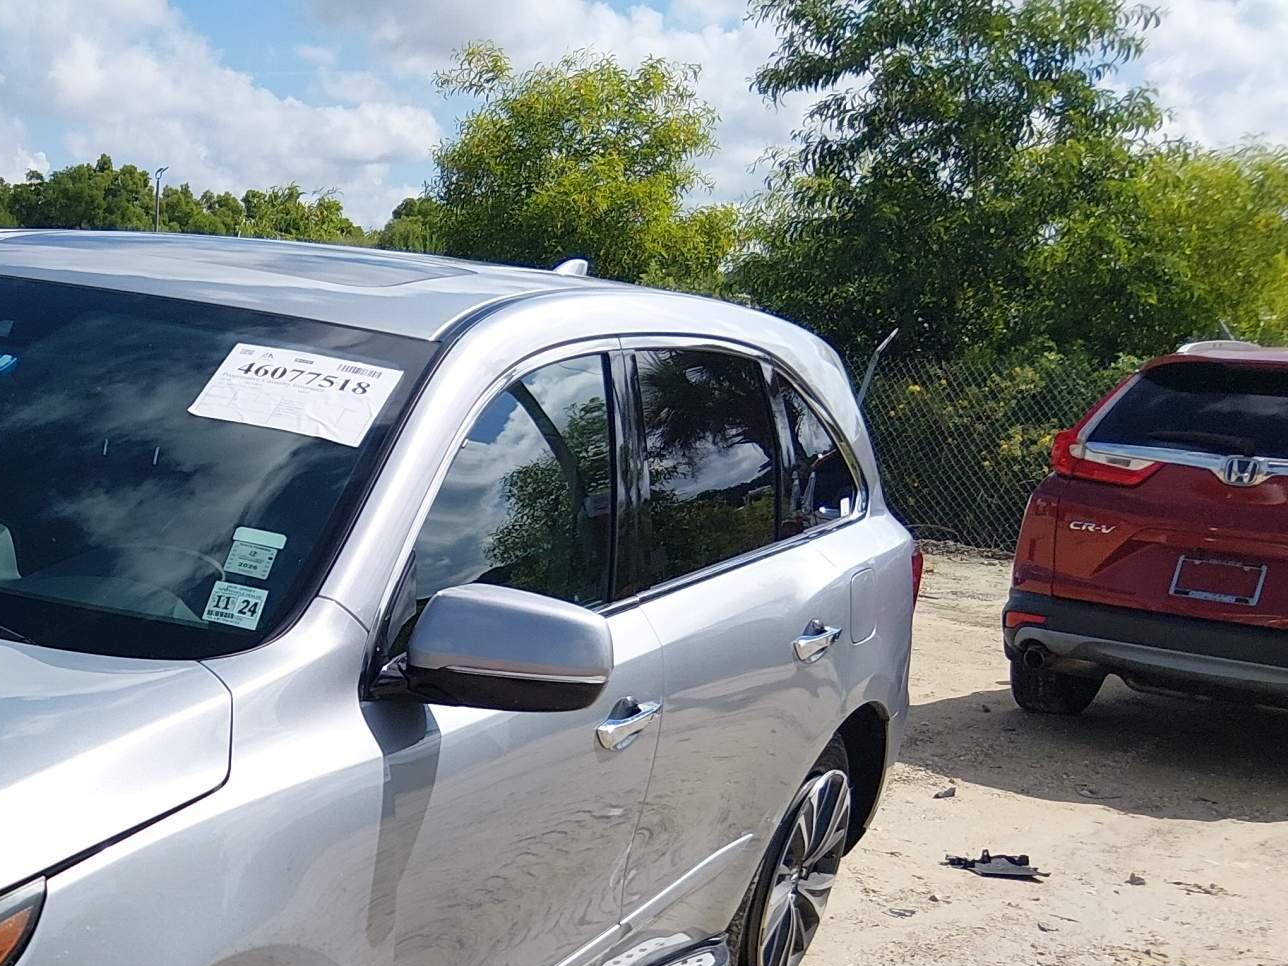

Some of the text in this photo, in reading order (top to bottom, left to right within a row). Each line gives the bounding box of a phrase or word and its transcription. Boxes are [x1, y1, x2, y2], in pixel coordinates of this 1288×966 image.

[237, 361, 372, 396] 46077518
[1068, 520, 1116, 534] CR-V
[213, 595, 231, 611] 11
[237, 599, 259, 617] 24
